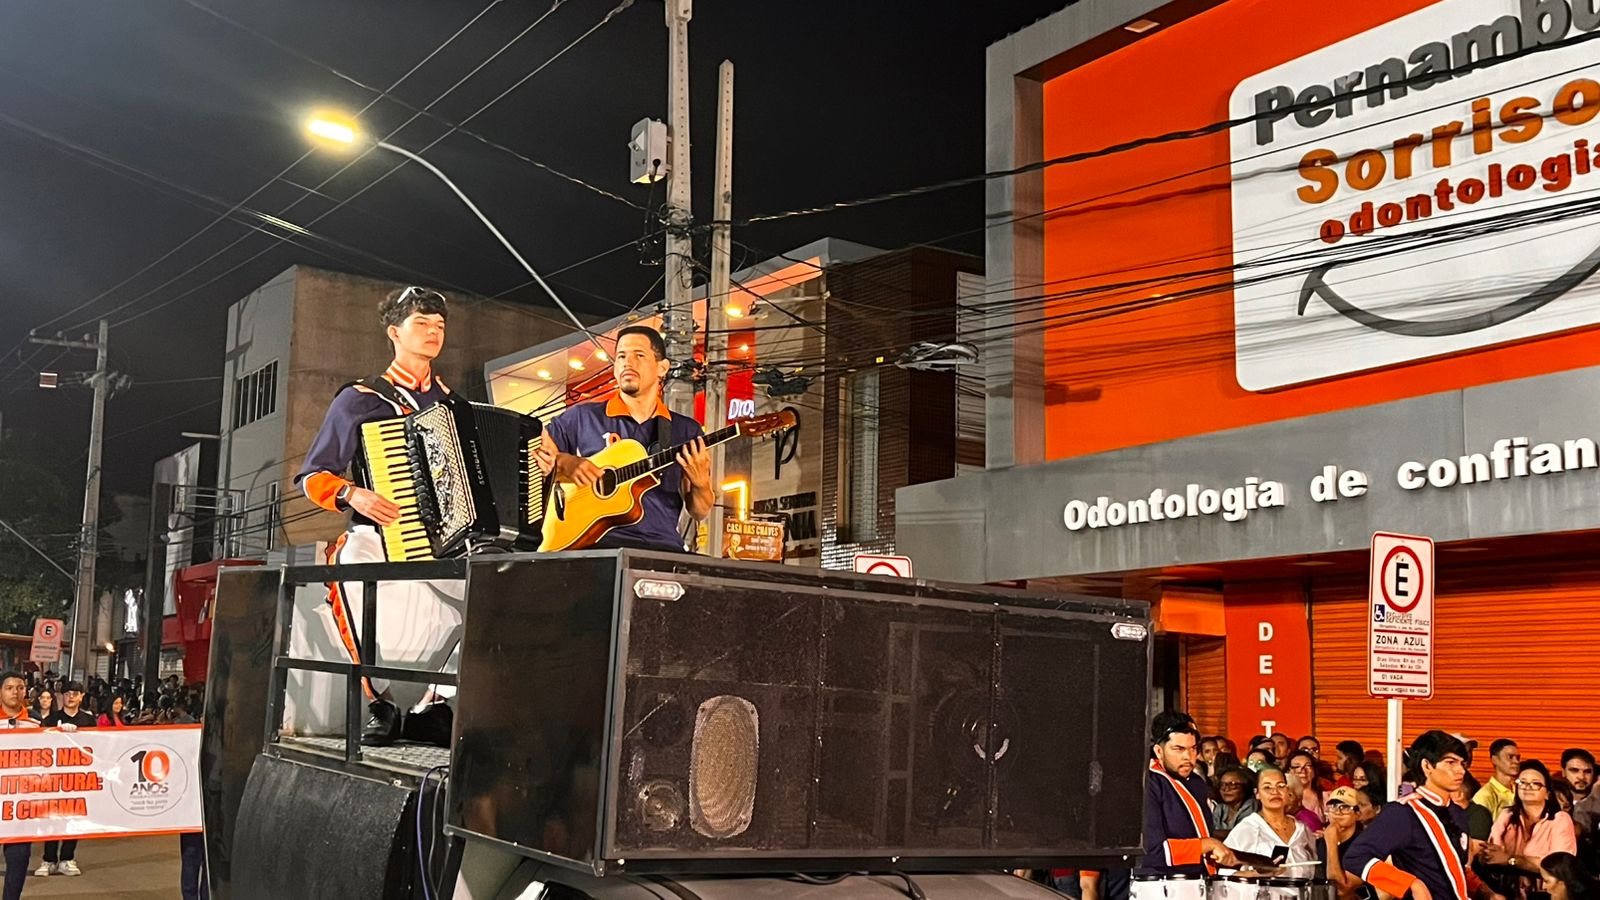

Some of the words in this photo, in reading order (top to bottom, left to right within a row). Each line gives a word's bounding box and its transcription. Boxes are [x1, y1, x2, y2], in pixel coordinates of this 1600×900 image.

[1297, 78, 1600, 204] Sorriso
[469, 439, 486, 486] SCANDALLI
[1064, 476, 1286, 531] Odontologia
[1310, 465, 1369, 503] de
[1397, 436, 1599, 490] confian
[726, 523, 742, 534] CASA
[743, 524, 756, 536] DAS
[756, 525, 779, 537] CHAVES
[1395, 562, 1409, 597] E
[45, 626, 52, 636] E
[1376, 635, 1398, 645] ZONA
[1404, 637, 1426, 647] AZUL
[56, 747, 94, 767] NAS
[130, 750, 170, 782] 10
[130, 783, 169, 795] ANOS
[2, 801, 14, 820] E
[16, 797, 88, 820] CINEMA
